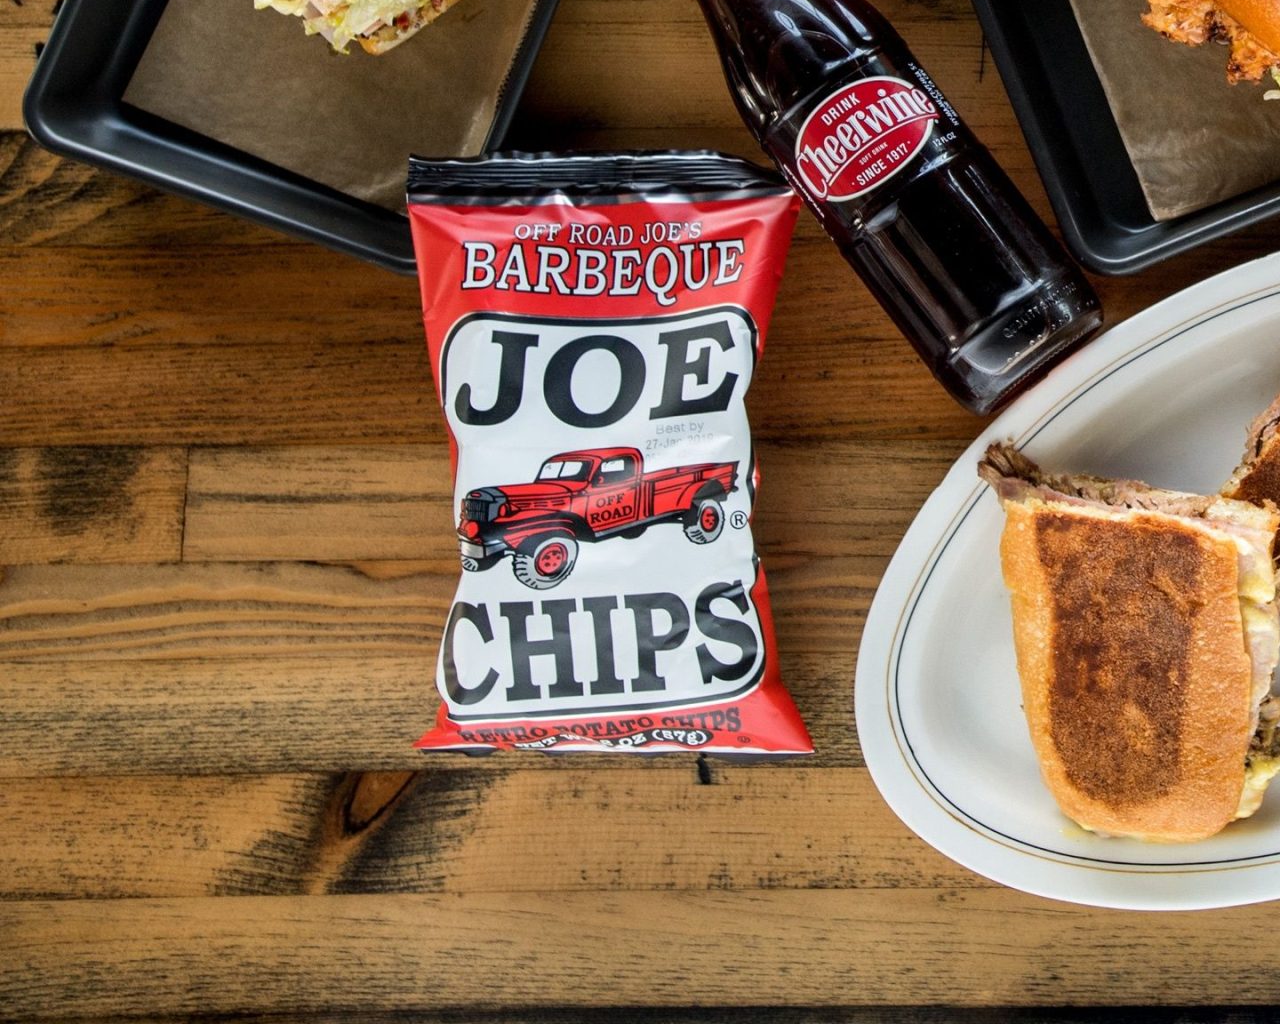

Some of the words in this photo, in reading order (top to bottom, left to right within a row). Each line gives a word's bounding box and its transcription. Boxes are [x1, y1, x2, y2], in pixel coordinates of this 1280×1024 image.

[821, 92, 861, 126] DRINK
[796, 88, 936, 199] Cheerwine
[858, 150, 873, 166] SOFT
[871, 141, 889, 157] DRINK
[856, 160, 887, 187] SINCE
[886, 143, 909, 164] 1917
[514, 223, 561, 242] OFF
[569, 223, 635, 246] ROAD
[640, 221, 702, 246] JOE'S
[462, 240, 746, 306] BARBEQUE
[454, 320, 739, 428] JOE
[655, 423, 685, 435] Best
[689, 422, 705, 433] by
[590, 505, 634, 526] ROAD
[594, 492, 625, 508] OFF
[441, 579, 758, 706] CHIPS
[459, 725, 549, 745] RETRO
[554, 717, 654, 739] POTATO
[660, 707, 742, 732] CHIPS
[651, 728, 708, 746] (57g)
